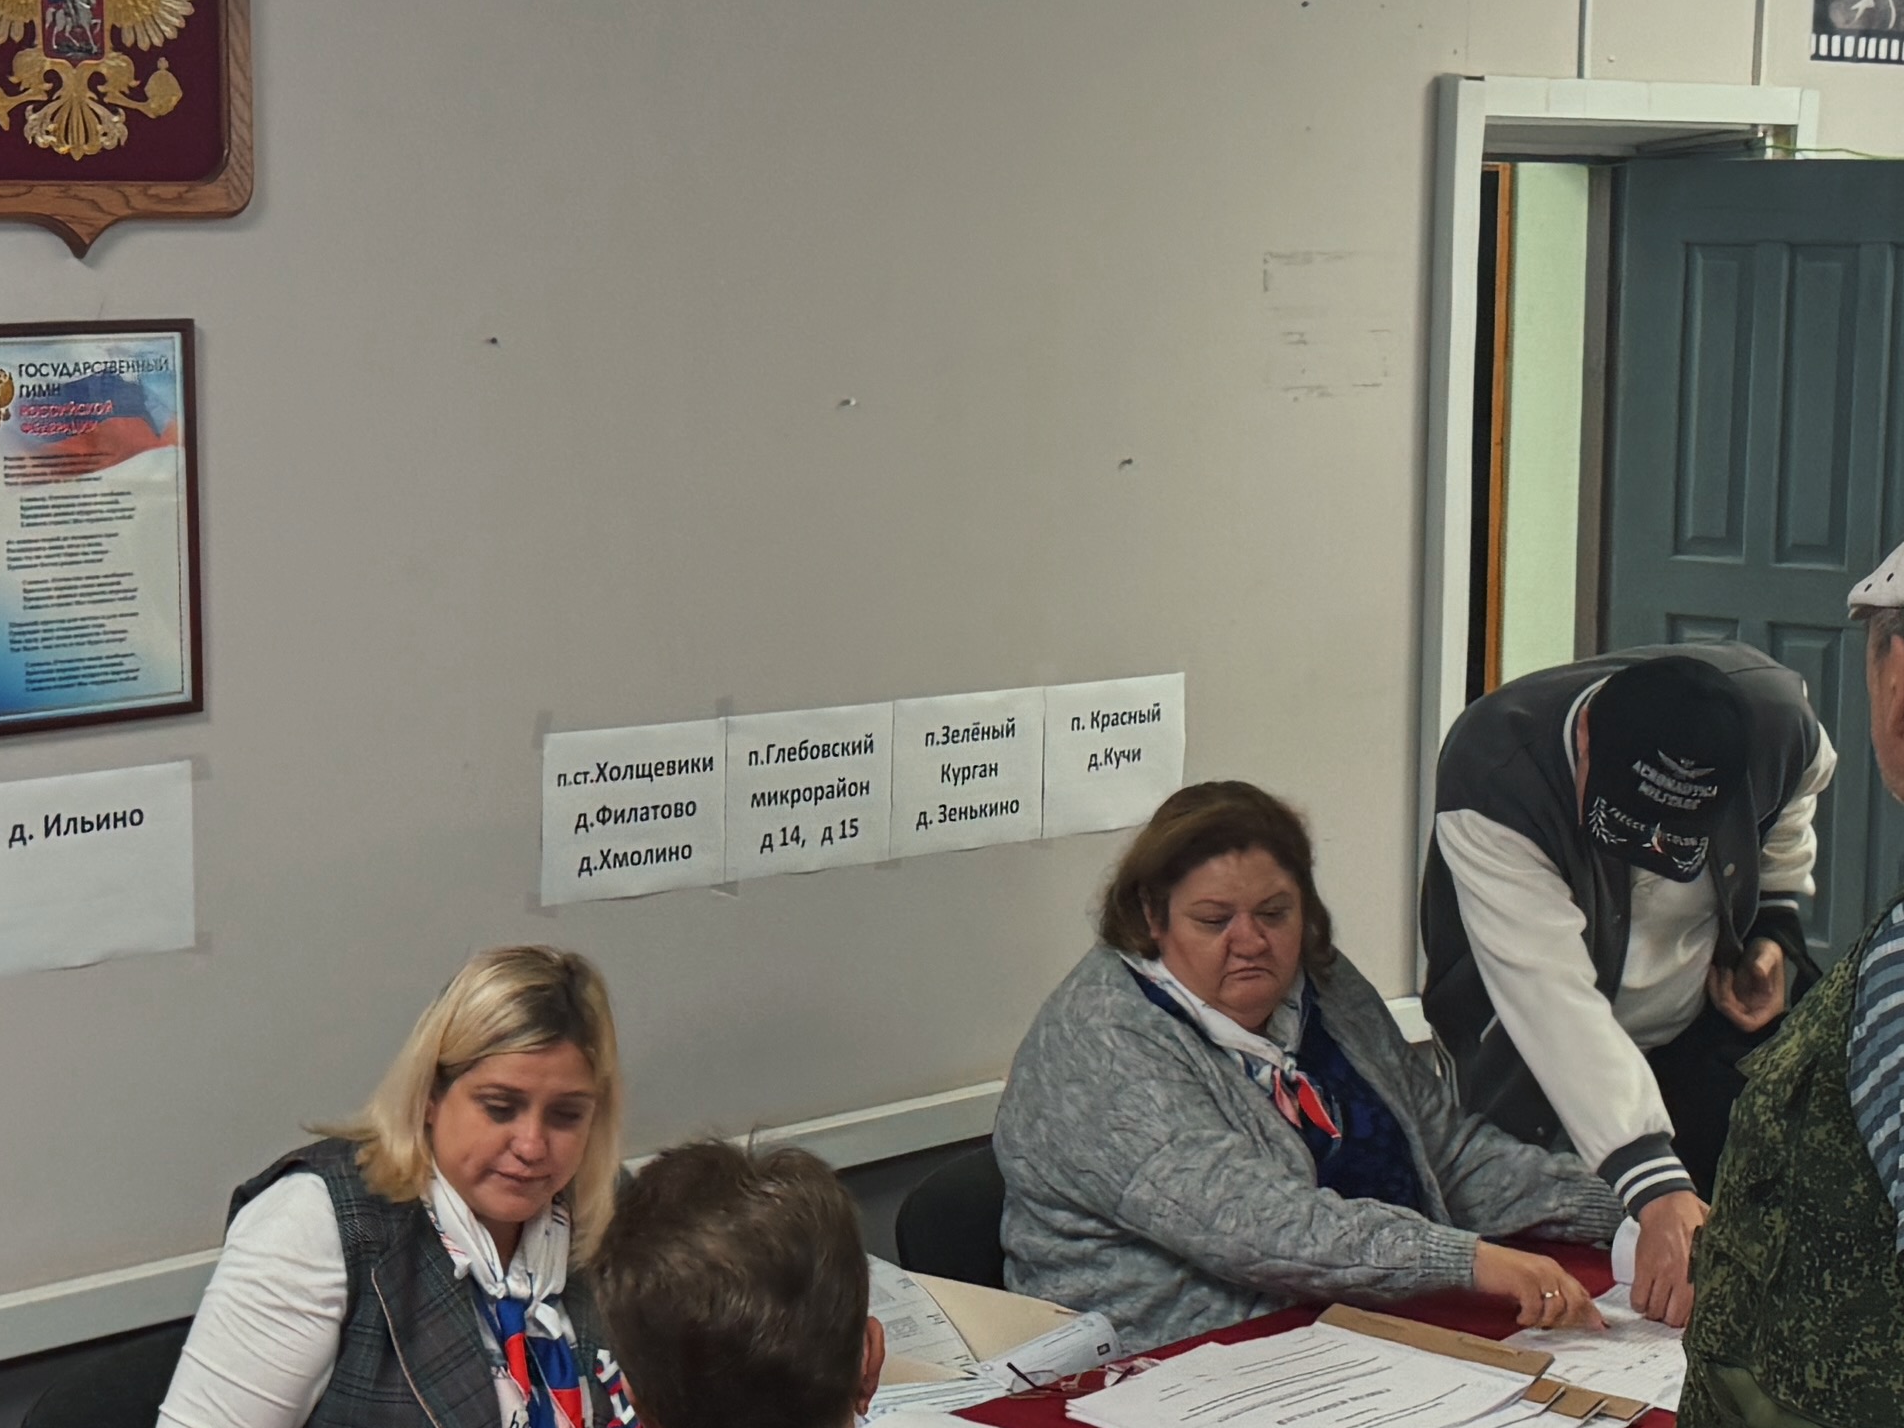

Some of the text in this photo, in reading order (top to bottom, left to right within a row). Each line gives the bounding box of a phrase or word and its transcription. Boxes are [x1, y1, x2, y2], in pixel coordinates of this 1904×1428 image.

[18, 355, 170, 378] ГОСУДАРСТВЕННЫЙ
[18, 382, 61, 399] ГИМН
[924, 717, 1015, 747] п.Зелёный
[1071, 702, 1161, 733] п. Красный
[748, 733, 874, 766] п.Глебовский
[1087, 747, 1141, 772] д.Кучи
[557, 756, 714, 787] п.ст.Холщевики
[941, 762, 998, 786] Курган
[751, 777, 870, 809] микрорайон
[8, 808, 144, 848] д. Ильино
[574, 800, 697, 834] д.Филатово
[916, 799, 1019, 831] д. Зенькино
[760, 818, 859, 854] д 14, д 15
[577, 844, 693, 878] д.Хмолино
